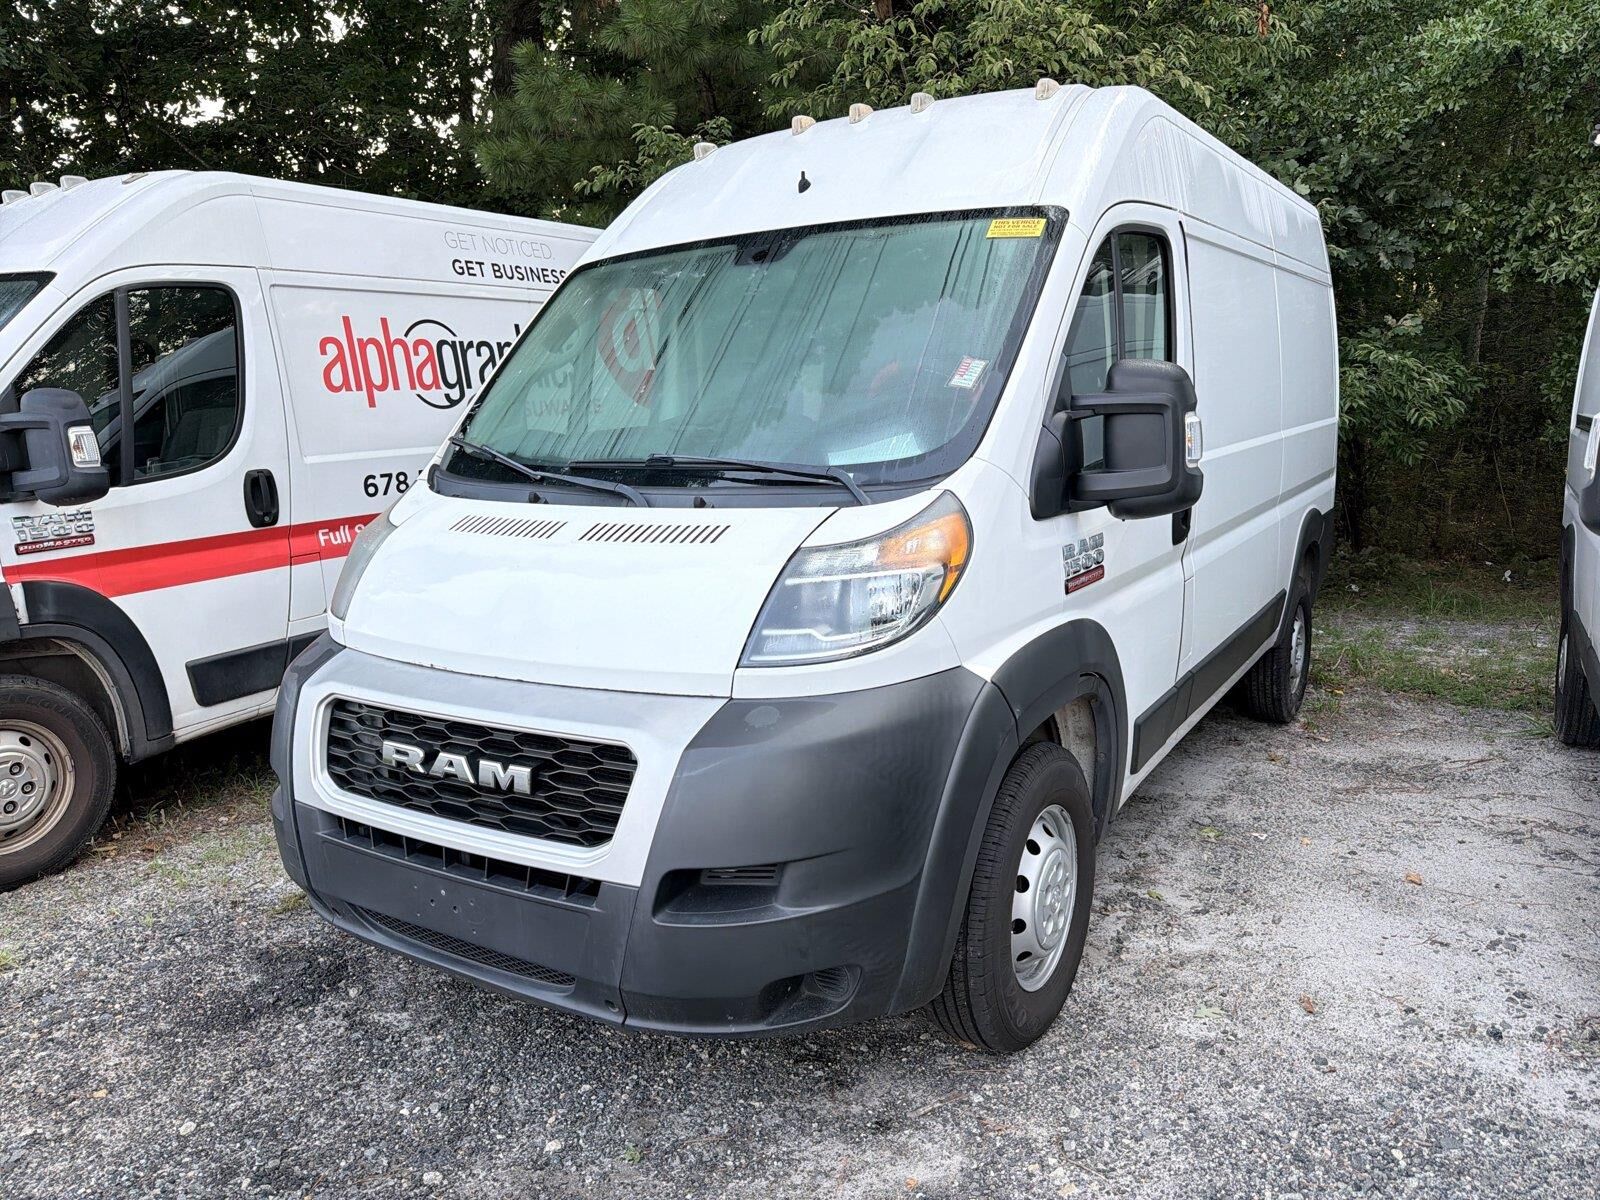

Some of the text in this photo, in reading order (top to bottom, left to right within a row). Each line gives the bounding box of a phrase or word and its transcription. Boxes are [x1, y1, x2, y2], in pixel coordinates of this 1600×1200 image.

[444, 231, 478, 250] GET
[452, 259, 485, 278] GET
[319, 315, 521, 409] alphagra
[12, 509, 93, 529] RAM
[17, 521, 95, 542] 1500
[318, 525, 352, 547] Full
[1062, 532, 1104, 561] RAM
[1064, 548, 1105, 577] 1500
[382, 741, 532, 794] RAM
